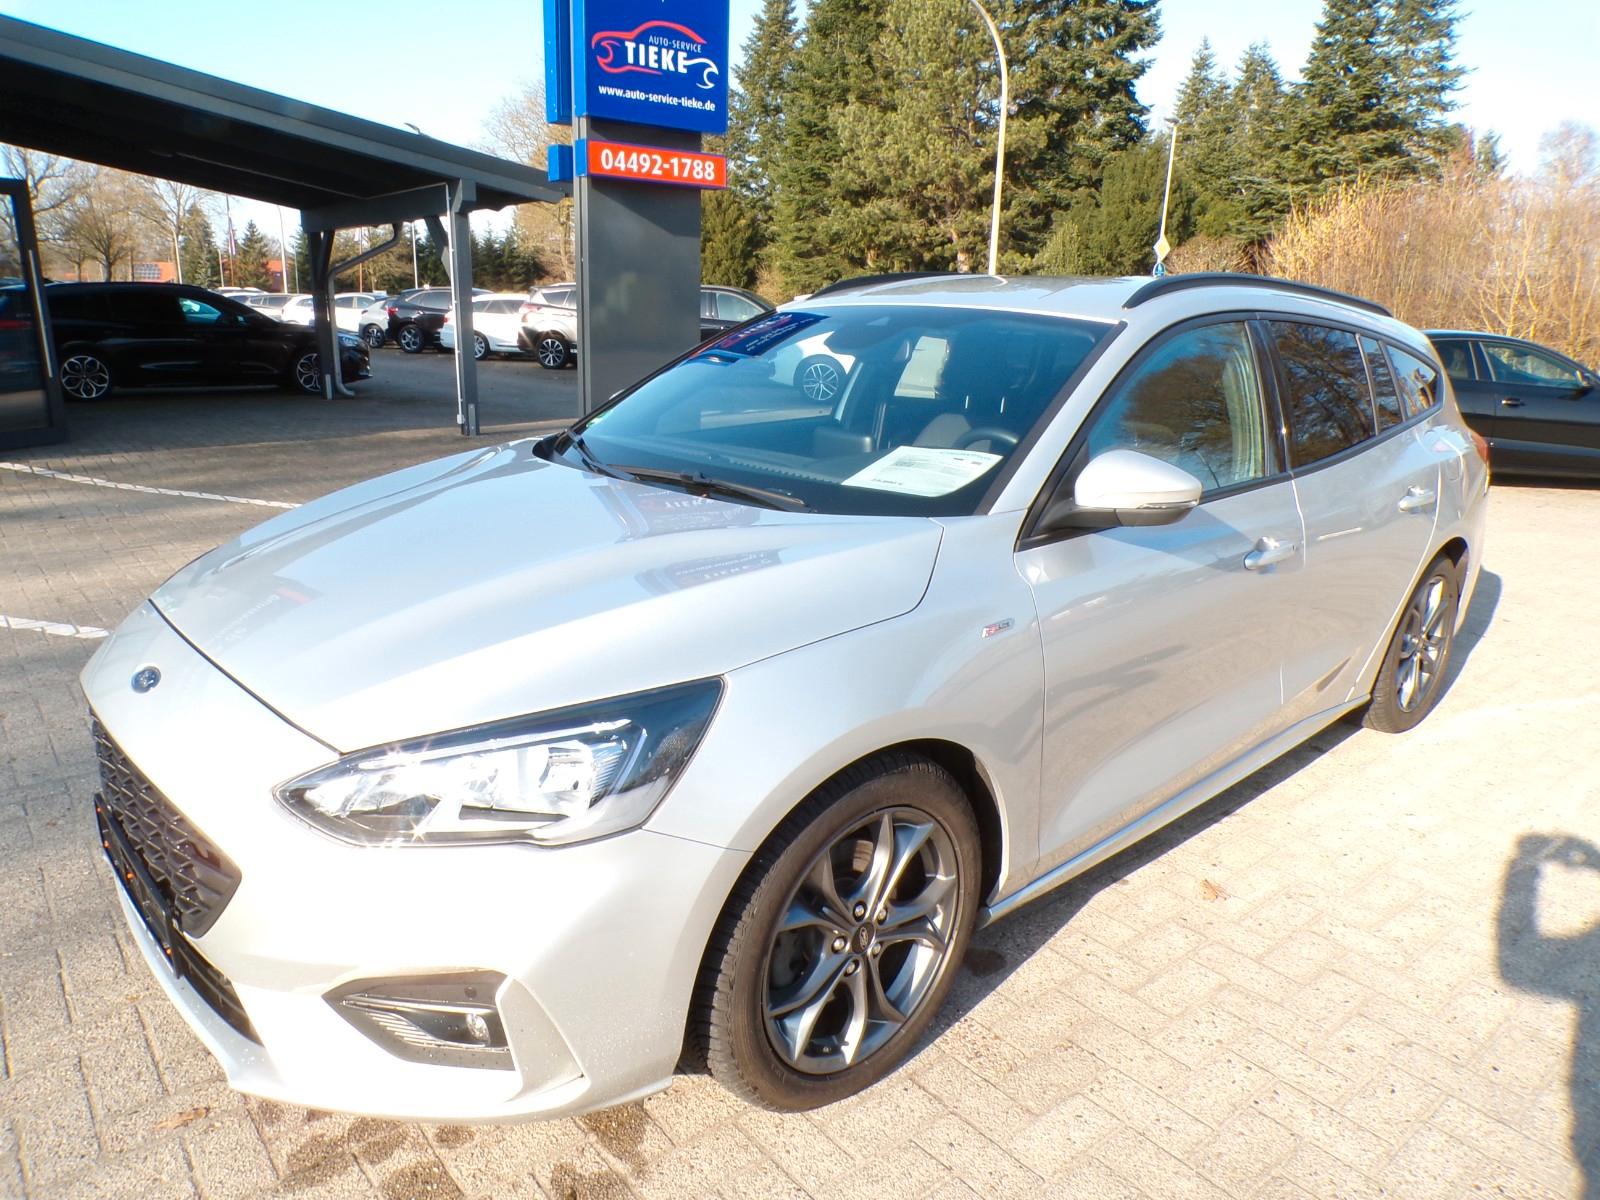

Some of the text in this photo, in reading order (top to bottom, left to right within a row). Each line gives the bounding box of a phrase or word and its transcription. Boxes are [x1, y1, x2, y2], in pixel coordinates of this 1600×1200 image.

[625, 41, 688, 74] TIEKE
[649, 35, 702, 53] AUTO-SERVICE
[598, 86, 716, 111] www.auto-service-tieke.de
[601, 149, 715, 180] 04492-1788
